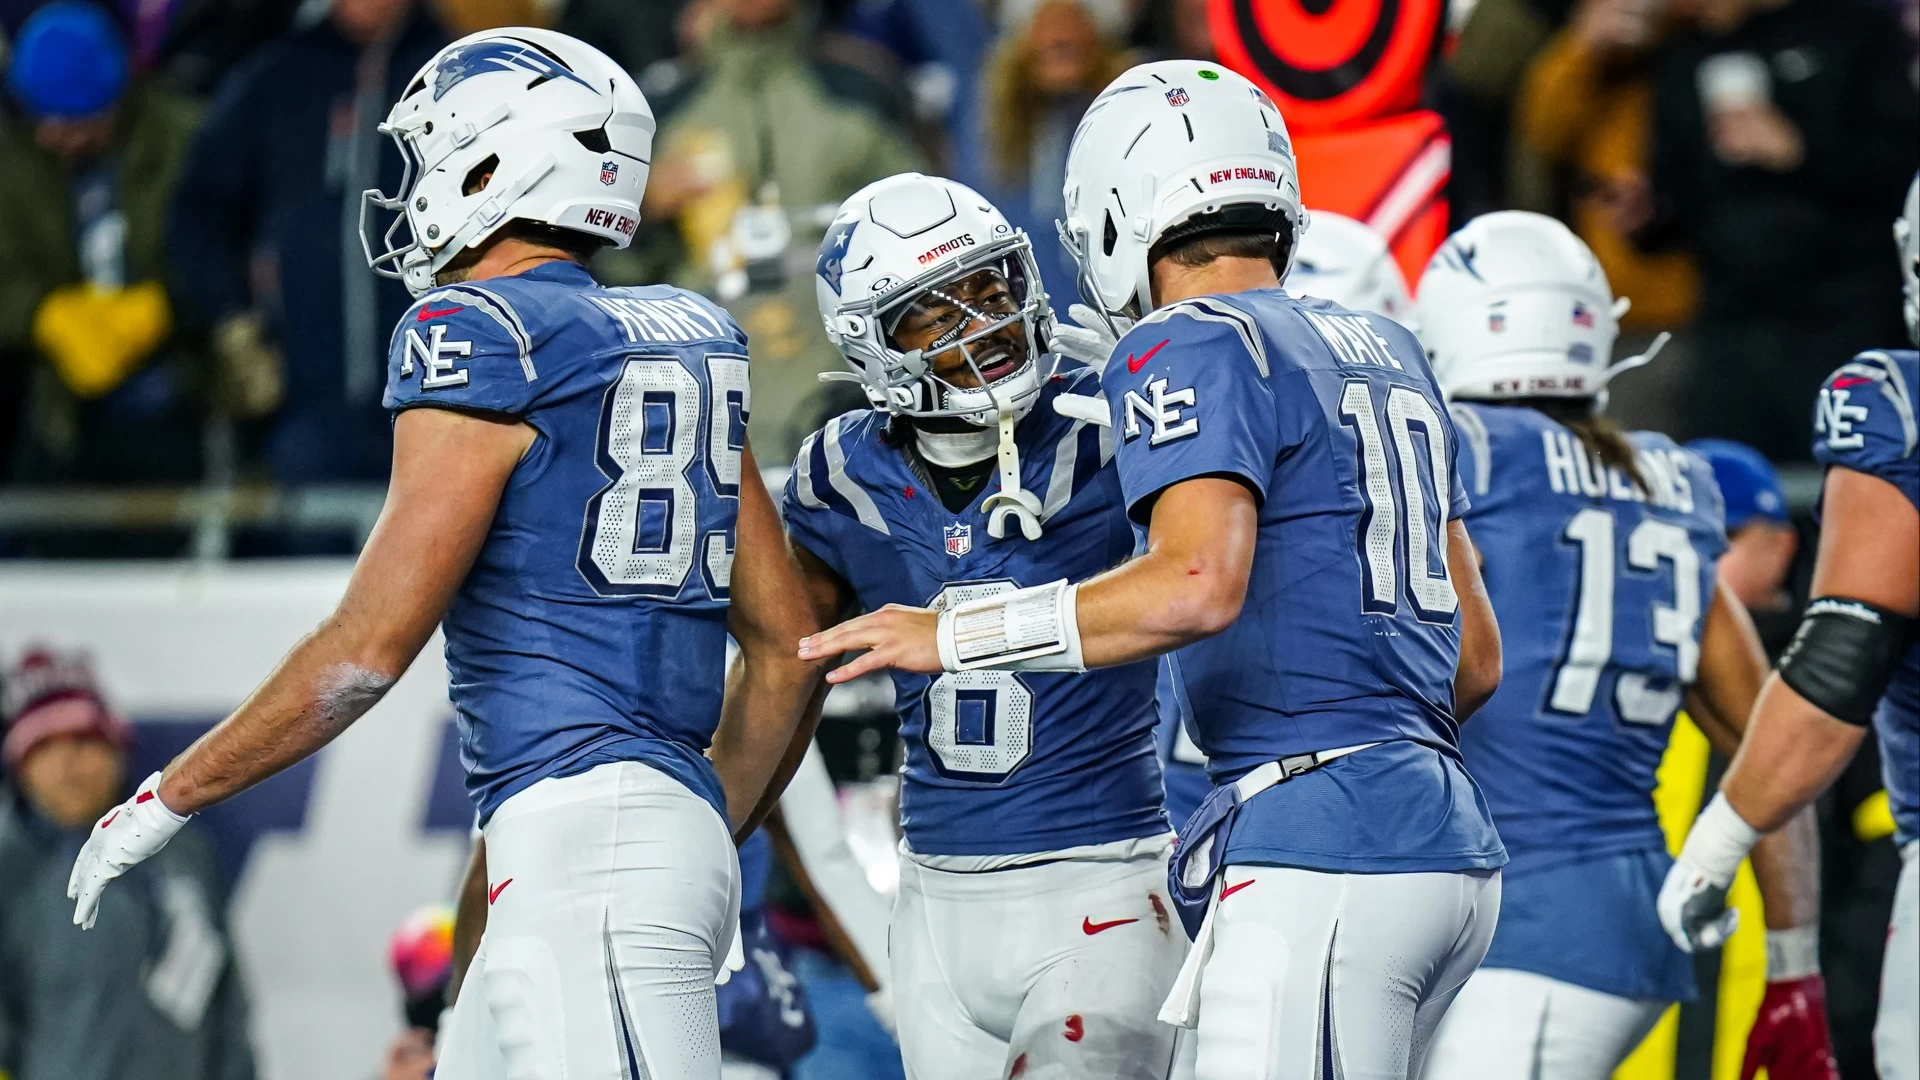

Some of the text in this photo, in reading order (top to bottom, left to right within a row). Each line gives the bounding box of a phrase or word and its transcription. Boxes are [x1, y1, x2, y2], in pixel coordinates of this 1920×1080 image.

[1209, 168, 1276, 184] NEW ENGLAND
[584, 208, 617, 229] NEW
[917, 233, 976, 264] PATRIOTS
[589, 297, 725, 342] HENRY
[1303, 311, 1404, 371] MAYE
[400, 324, 472, 393] NE
[1123, 374, 1199, 447] NE
[1815, 388, 1869, 450] NE
[575, 355, 751, 602] 85
[1337, 378, 1459, 627] 10
[1543, 508, 1702, 729] 13
